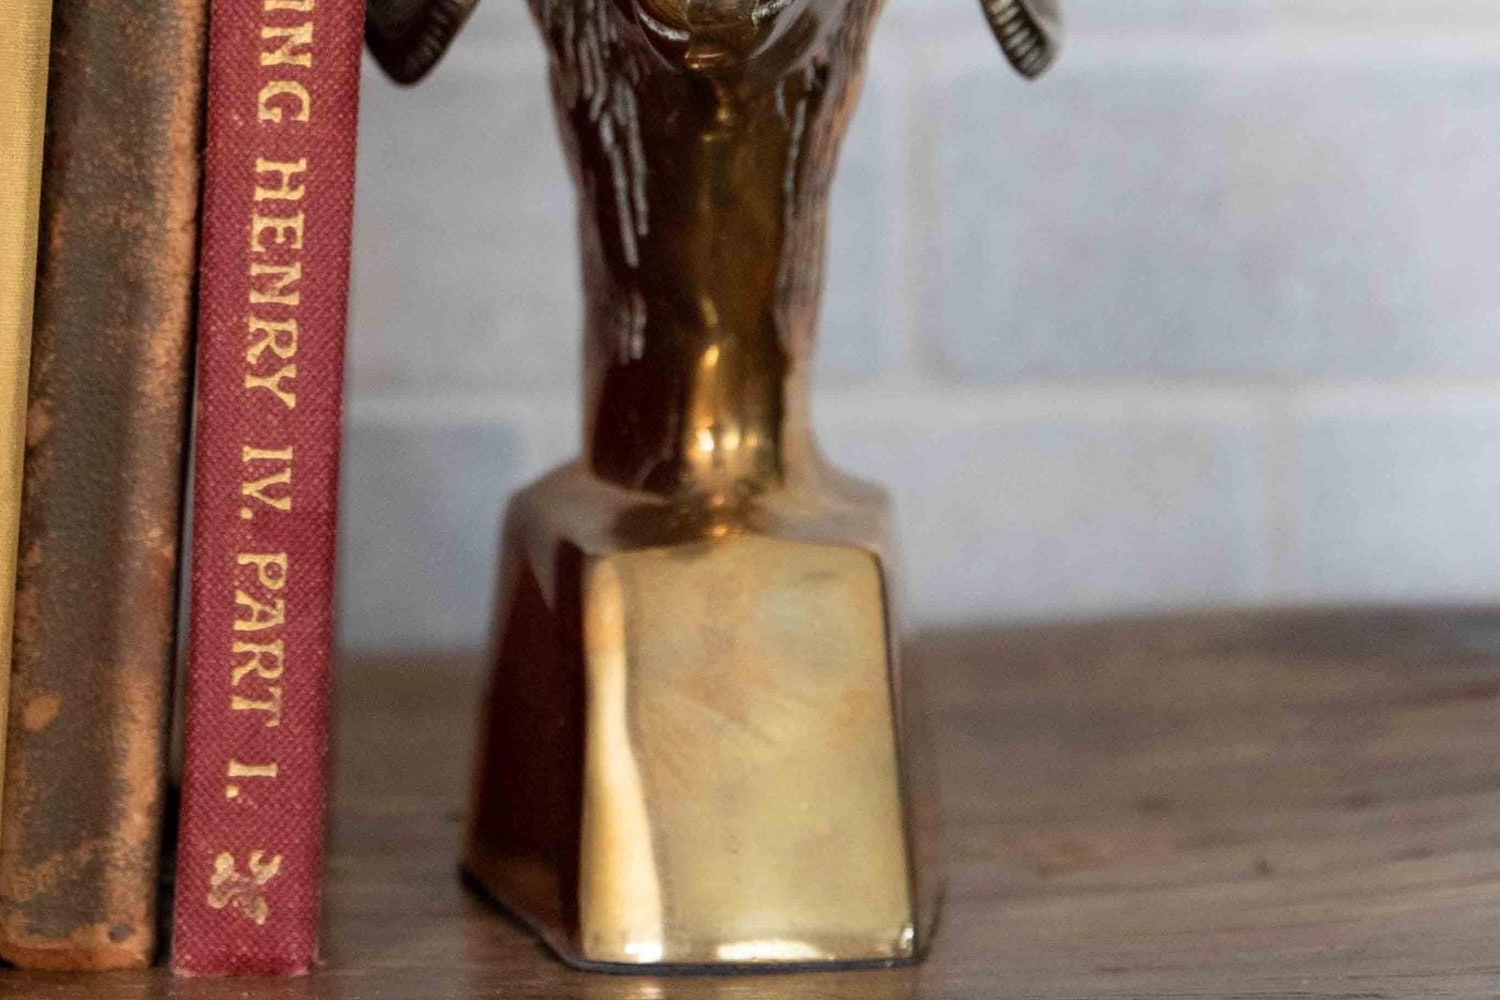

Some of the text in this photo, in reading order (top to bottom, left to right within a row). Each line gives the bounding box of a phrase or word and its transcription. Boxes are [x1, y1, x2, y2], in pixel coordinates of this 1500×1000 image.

[244, 157, 308, 410] HENRY
[239, 445, 294, 520] IV.
[231, 551, 289, 728] PART
[225, 760, 279, 799] I.
